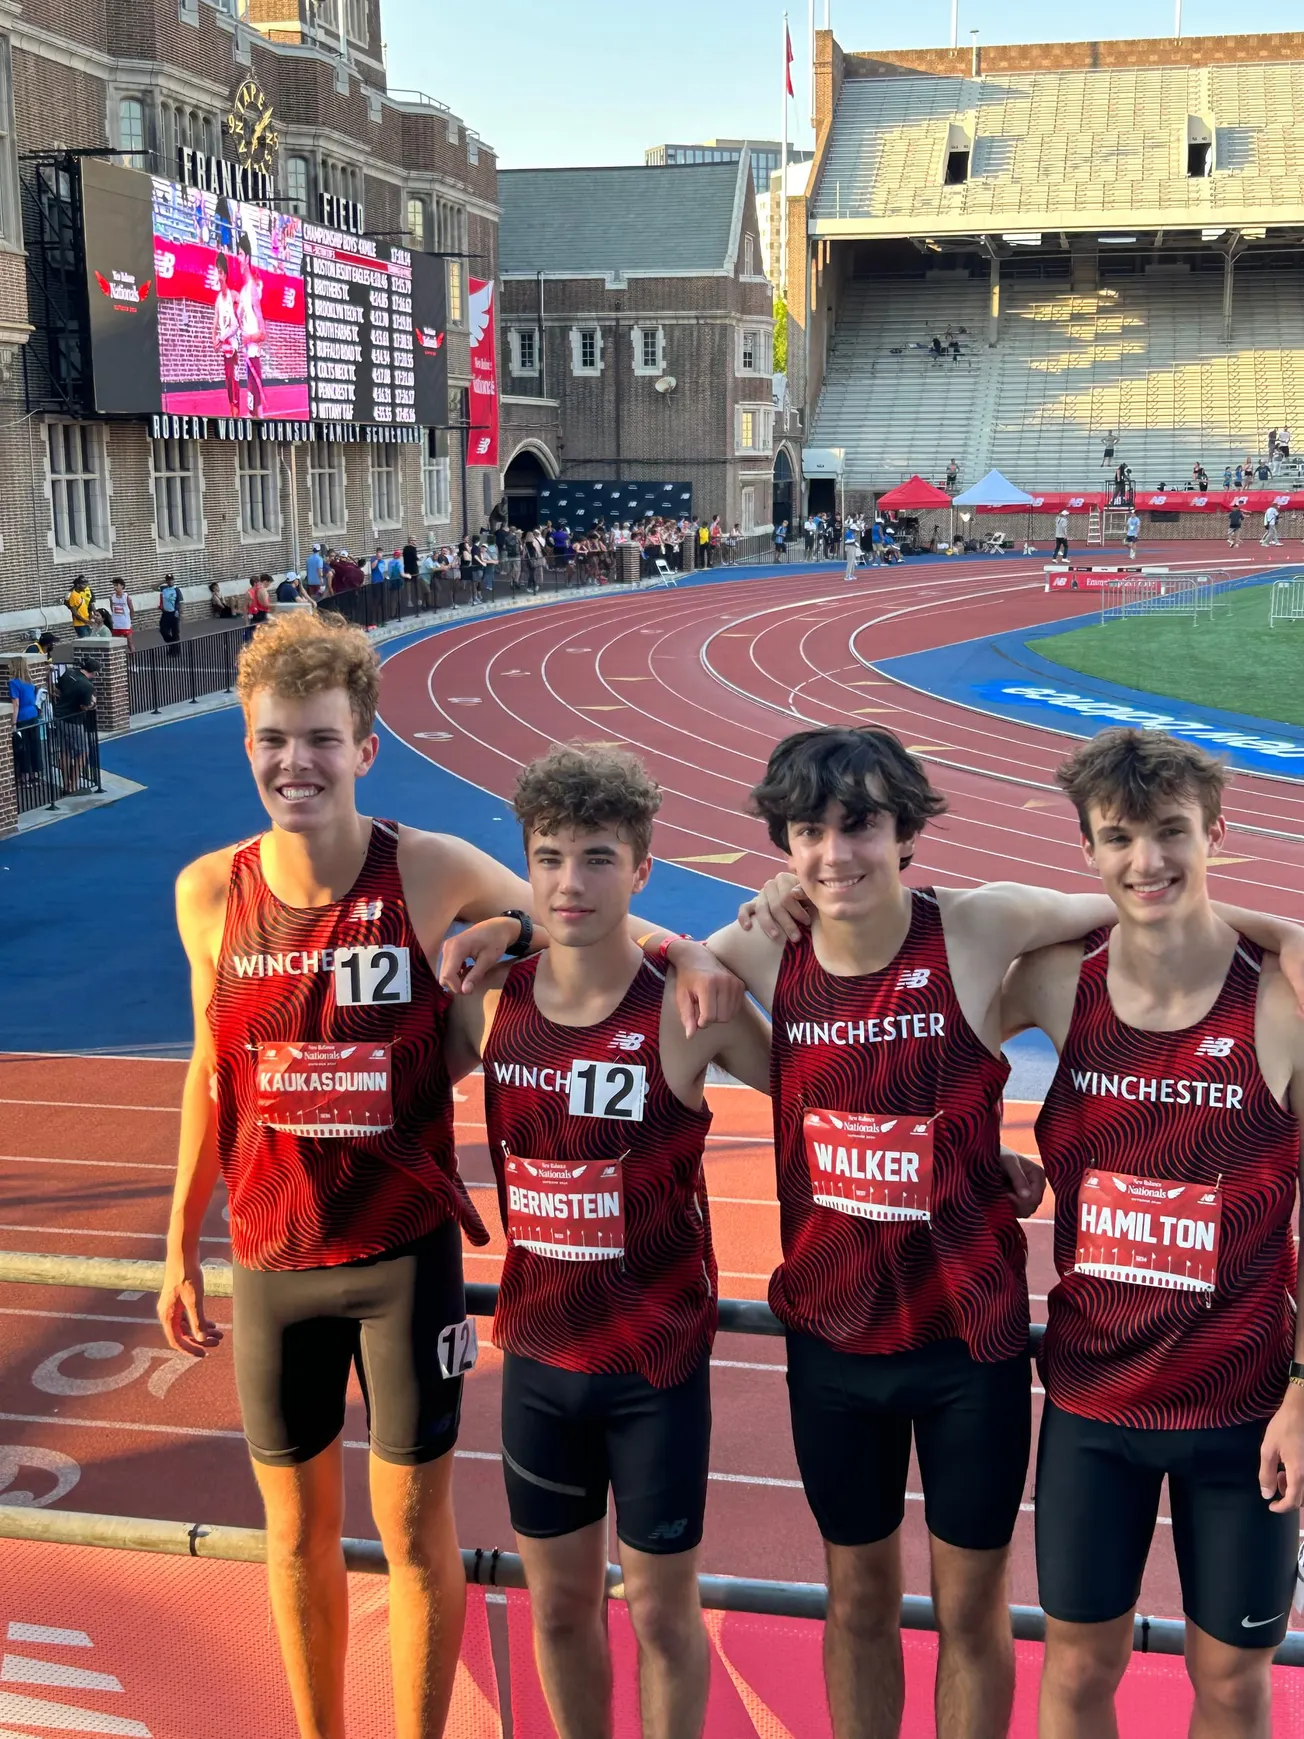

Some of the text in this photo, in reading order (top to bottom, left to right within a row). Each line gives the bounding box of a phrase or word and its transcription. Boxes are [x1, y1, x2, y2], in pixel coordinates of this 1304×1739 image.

[182, 147, 364, 235] FRANKLIN FIELD
[306, 255, 311, 272] 1
[306, 277, 312, 293] 2
[314, 278, 342, 299] BROTHERS
[307, 297, 313, 314] 3
[314, 299, 343, 320] BROOKLYN
[308, 319, 314, 335] 4
[315, 320, 334, 340] SOUTH
[309, 340, 314, 356] 5
[316, 341, 340, 359] BUFFALO
[310, 361, 315, 377] 6
[310, 380, 316, 398] 7
[311, 401, 317, 418] 9
[153, 415, 208, 439] ROBERT
[218, 418, 253, 440] WOOD
[261, 422, 315, 441] JOHNSON
[323, 423, 360, 442] FAMILY
[233, 949, 335, 978] WINCHE
[341, 951, 401, 1003] 12
[894, 968, 931, 991] NB
[786, 1013, 945, 1045] WINCHESTER
[607, 1030, 646, 1051] NB
[1194, 1036, 1235, 1057] NB
[304, 1051, 340, 1060] Nationals
[260, 1072, 387, 1092] KAUKASQUINN
[494, 1061, 571, 1094] WINCH
[577, 1064, 634, 1118] 12
[1070, 1068, 1243, 1110] WINCHESTER
[844, 1122, 880, 1133] Nationals
[813, 1141, 919, 1182] WALKER
[538, 1169, 572, 1179] Nationals
[509, 1185, 619, 1219] BERNSTEIN
[1128, 1185, 1167, 1199] Nationals
[1081, 1203, 1215, 1252] HAMILTON
[442, 1318, 473, 1374] 12
